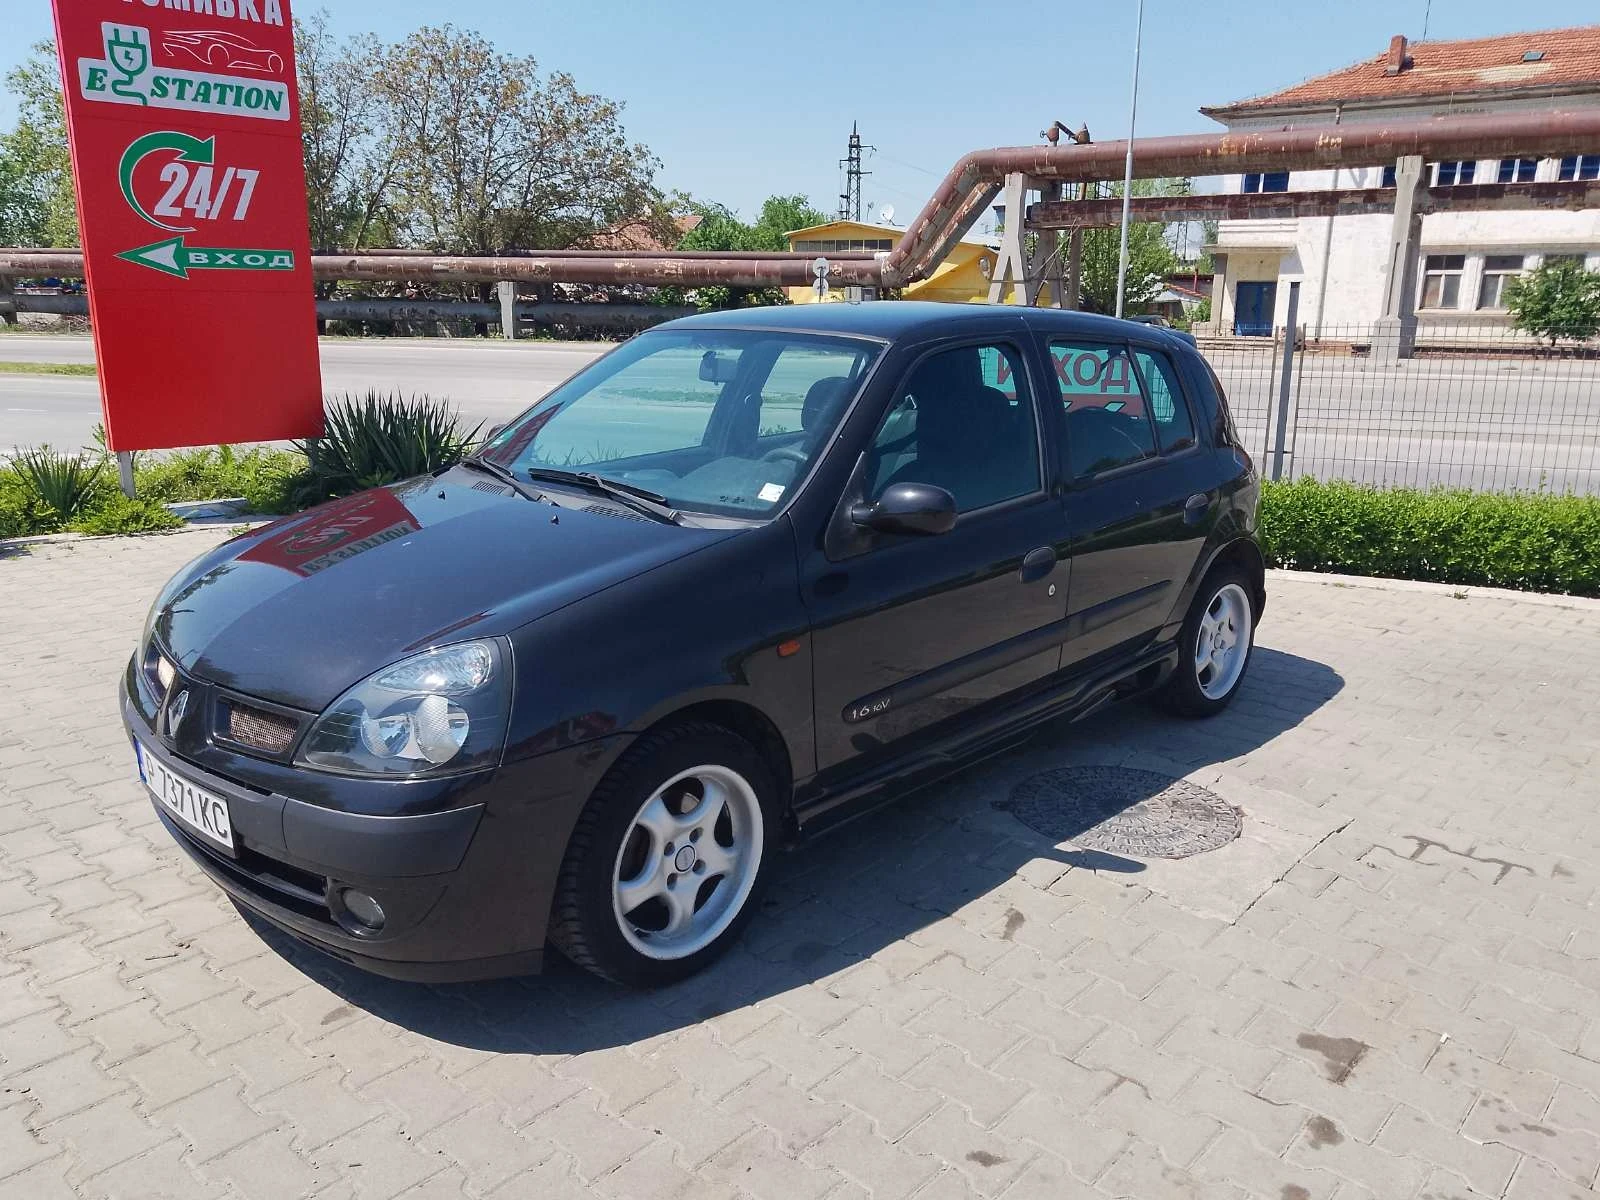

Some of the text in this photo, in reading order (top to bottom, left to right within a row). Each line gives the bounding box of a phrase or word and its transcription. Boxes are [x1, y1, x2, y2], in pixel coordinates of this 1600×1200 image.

[86, 67, 284, 112] E STATION
[153, 162, 260, 221] 24/7
[188, 251, 293, 268] ВХОД
[997, 352, 1131, 393] ИХОД
